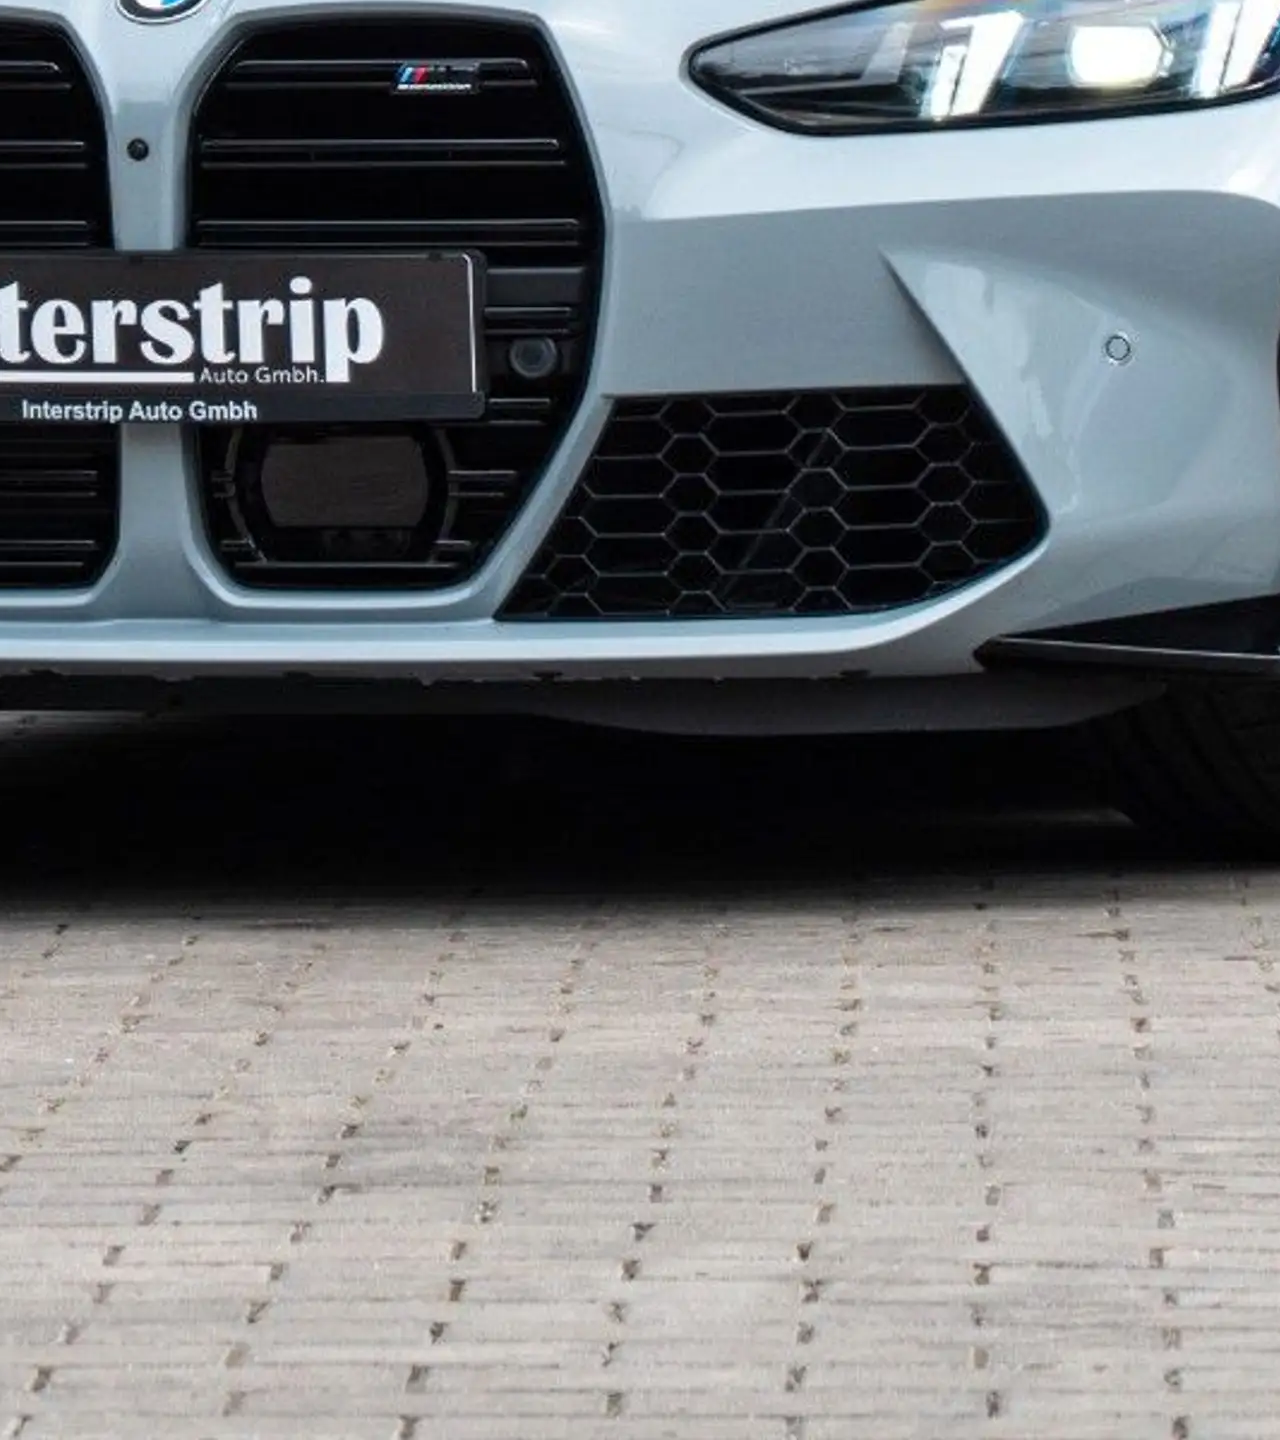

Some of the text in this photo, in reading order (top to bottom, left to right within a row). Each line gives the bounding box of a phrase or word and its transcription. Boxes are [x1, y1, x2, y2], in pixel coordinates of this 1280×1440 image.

[200, 366, 325, 384] Auto Gmbh.
[22, 399, 258, 424] Interstrip Auto Gmbh
